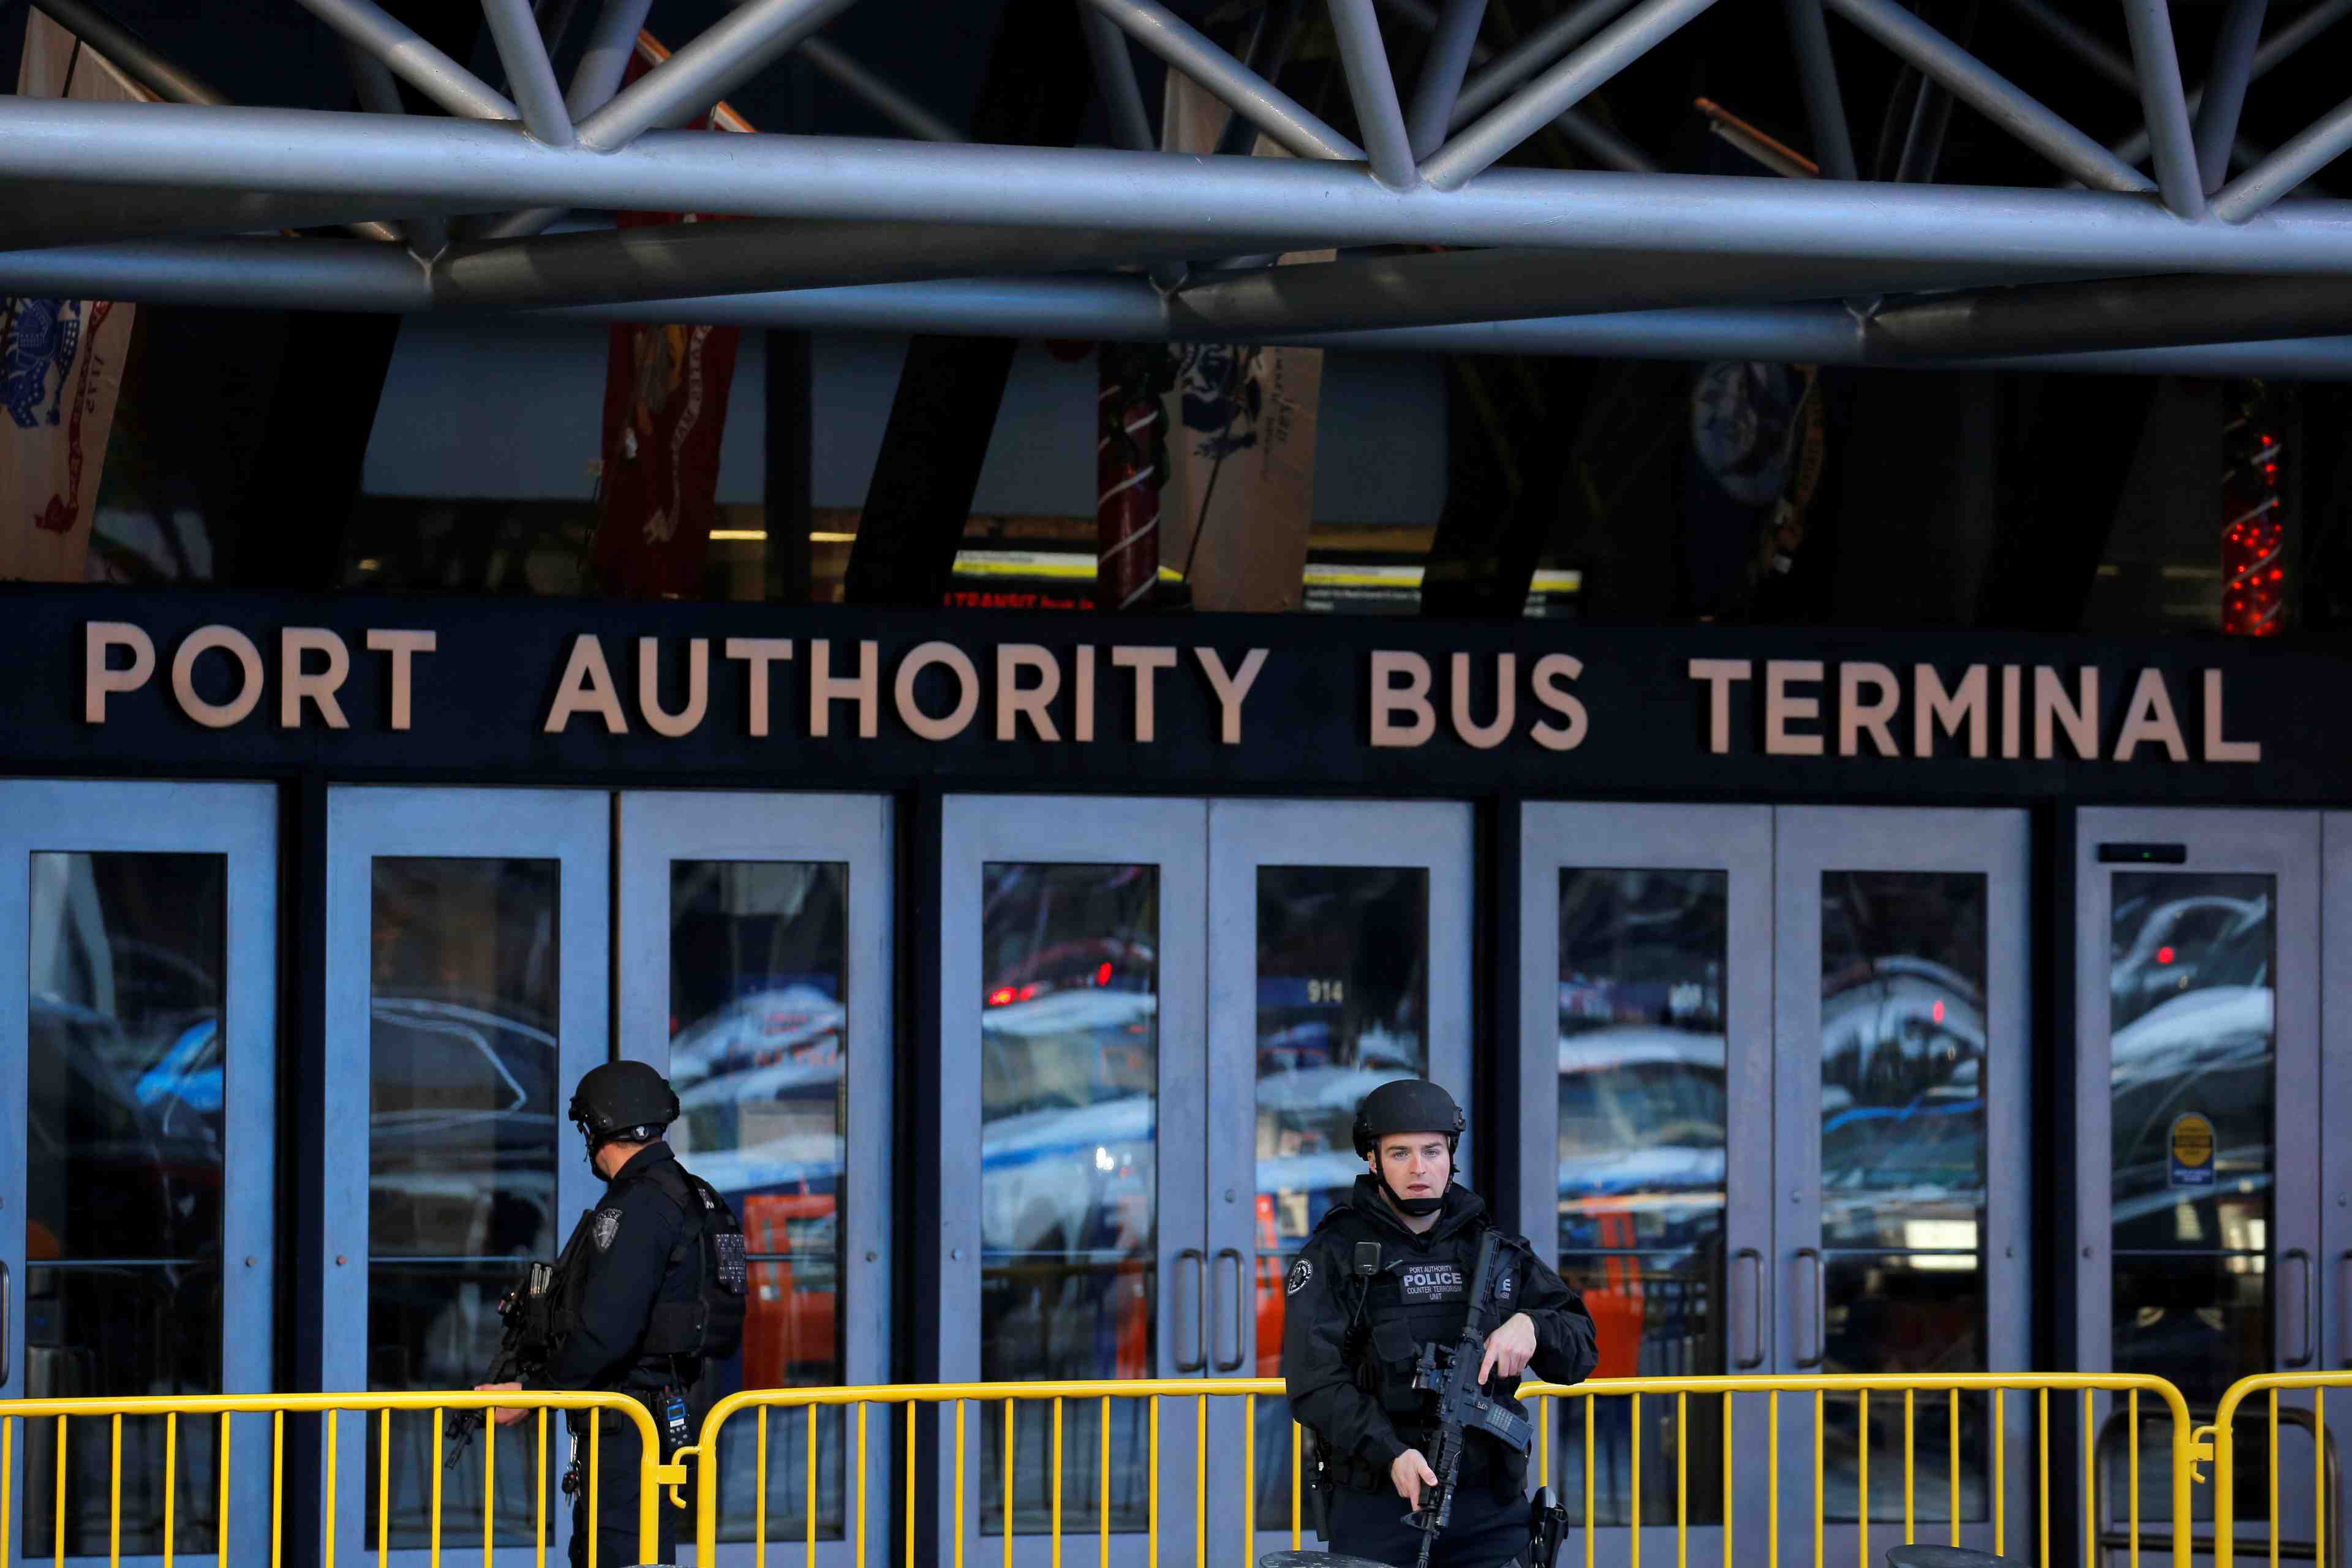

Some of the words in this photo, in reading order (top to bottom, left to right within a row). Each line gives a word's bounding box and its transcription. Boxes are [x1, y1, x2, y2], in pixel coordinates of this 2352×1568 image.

[85, 621, 437, 729] PORT
[544, 634, 1268, 744] AUTHORITY
[1371, 650, 1588, 751] BUS
[1689, 658, 2260, 761] TERMINAL
[1307, 979, 1343, 1003] 914
[1409, 1265, 1423, 1274] PORT
[1424, 1265, 1452, 1273] AUTHORITY
[1403, 1273, 1463, 1287] POLICE
